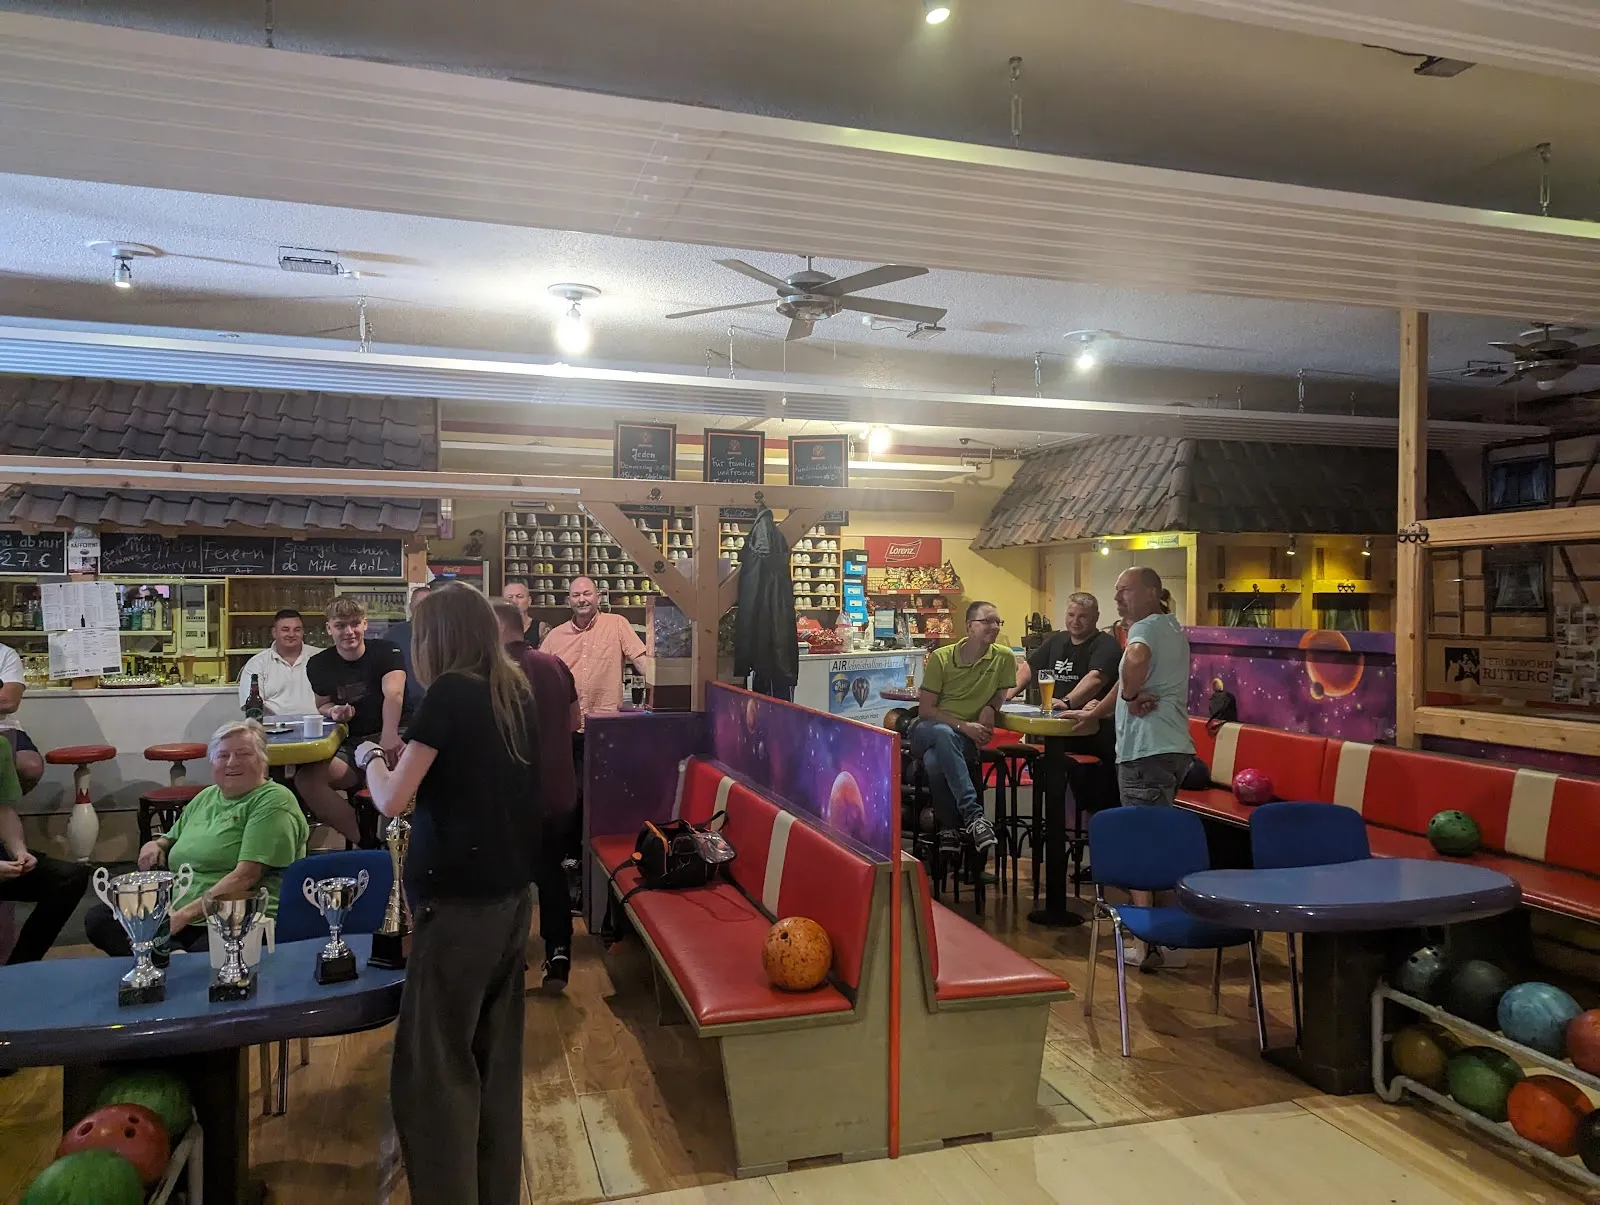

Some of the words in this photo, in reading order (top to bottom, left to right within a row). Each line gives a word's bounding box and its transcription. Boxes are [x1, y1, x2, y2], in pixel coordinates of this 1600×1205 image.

[727, 456, 755, 468] Familie
[20, 536, 35, 547] ab
[38, 539, 62, 548] nur
[203, 541, 264, 561] Feiern
[889, 545, 915, 555] Lorenz
[308, 559, 339, 572] Mitte
